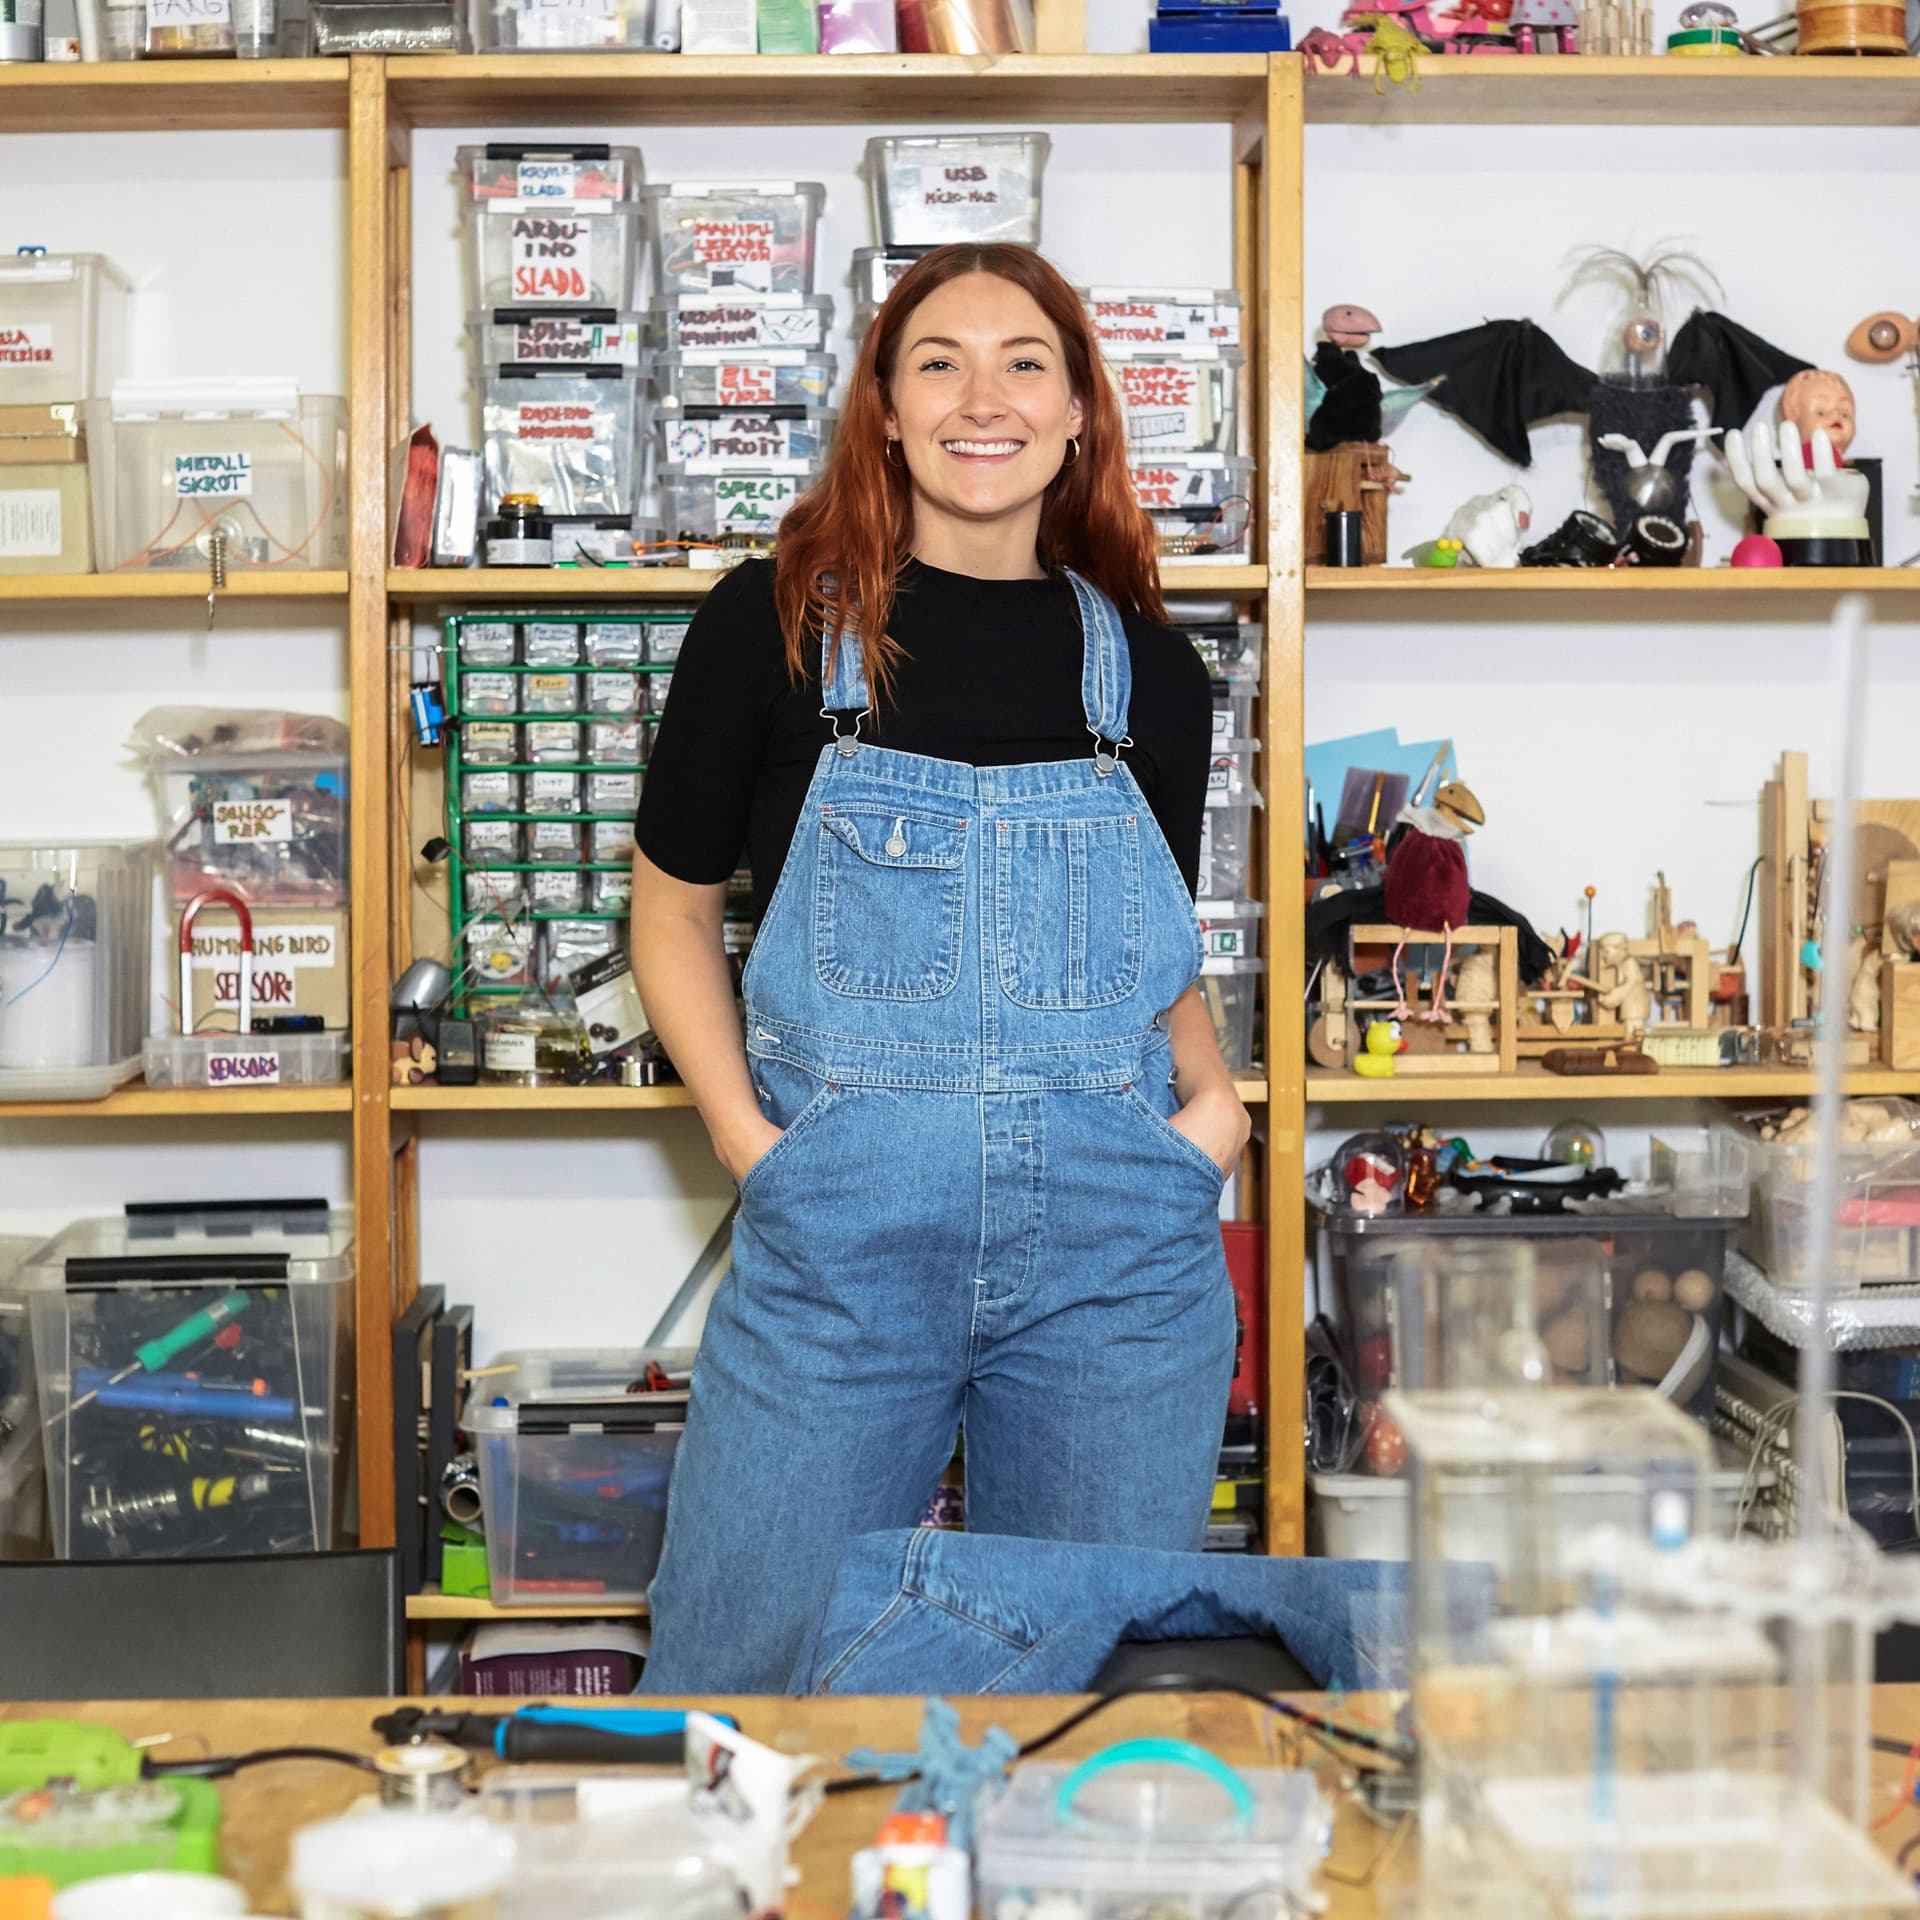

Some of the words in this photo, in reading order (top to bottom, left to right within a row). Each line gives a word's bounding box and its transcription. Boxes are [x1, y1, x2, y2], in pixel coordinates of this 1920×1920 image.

[944, 166, 988, 182] USB
[513, 219, 588, 240] ARDU-
[525, 242, 577, 258] INO
[515, 265, 586, 297] SLADD
[721, 365, 773, 389] EL-
[730, 417, 781, 437] ADA
[176, 453, 251, 472] METALL
[726, 501, 771, 521] AL
[289, 935, 331, 955] BIRD
